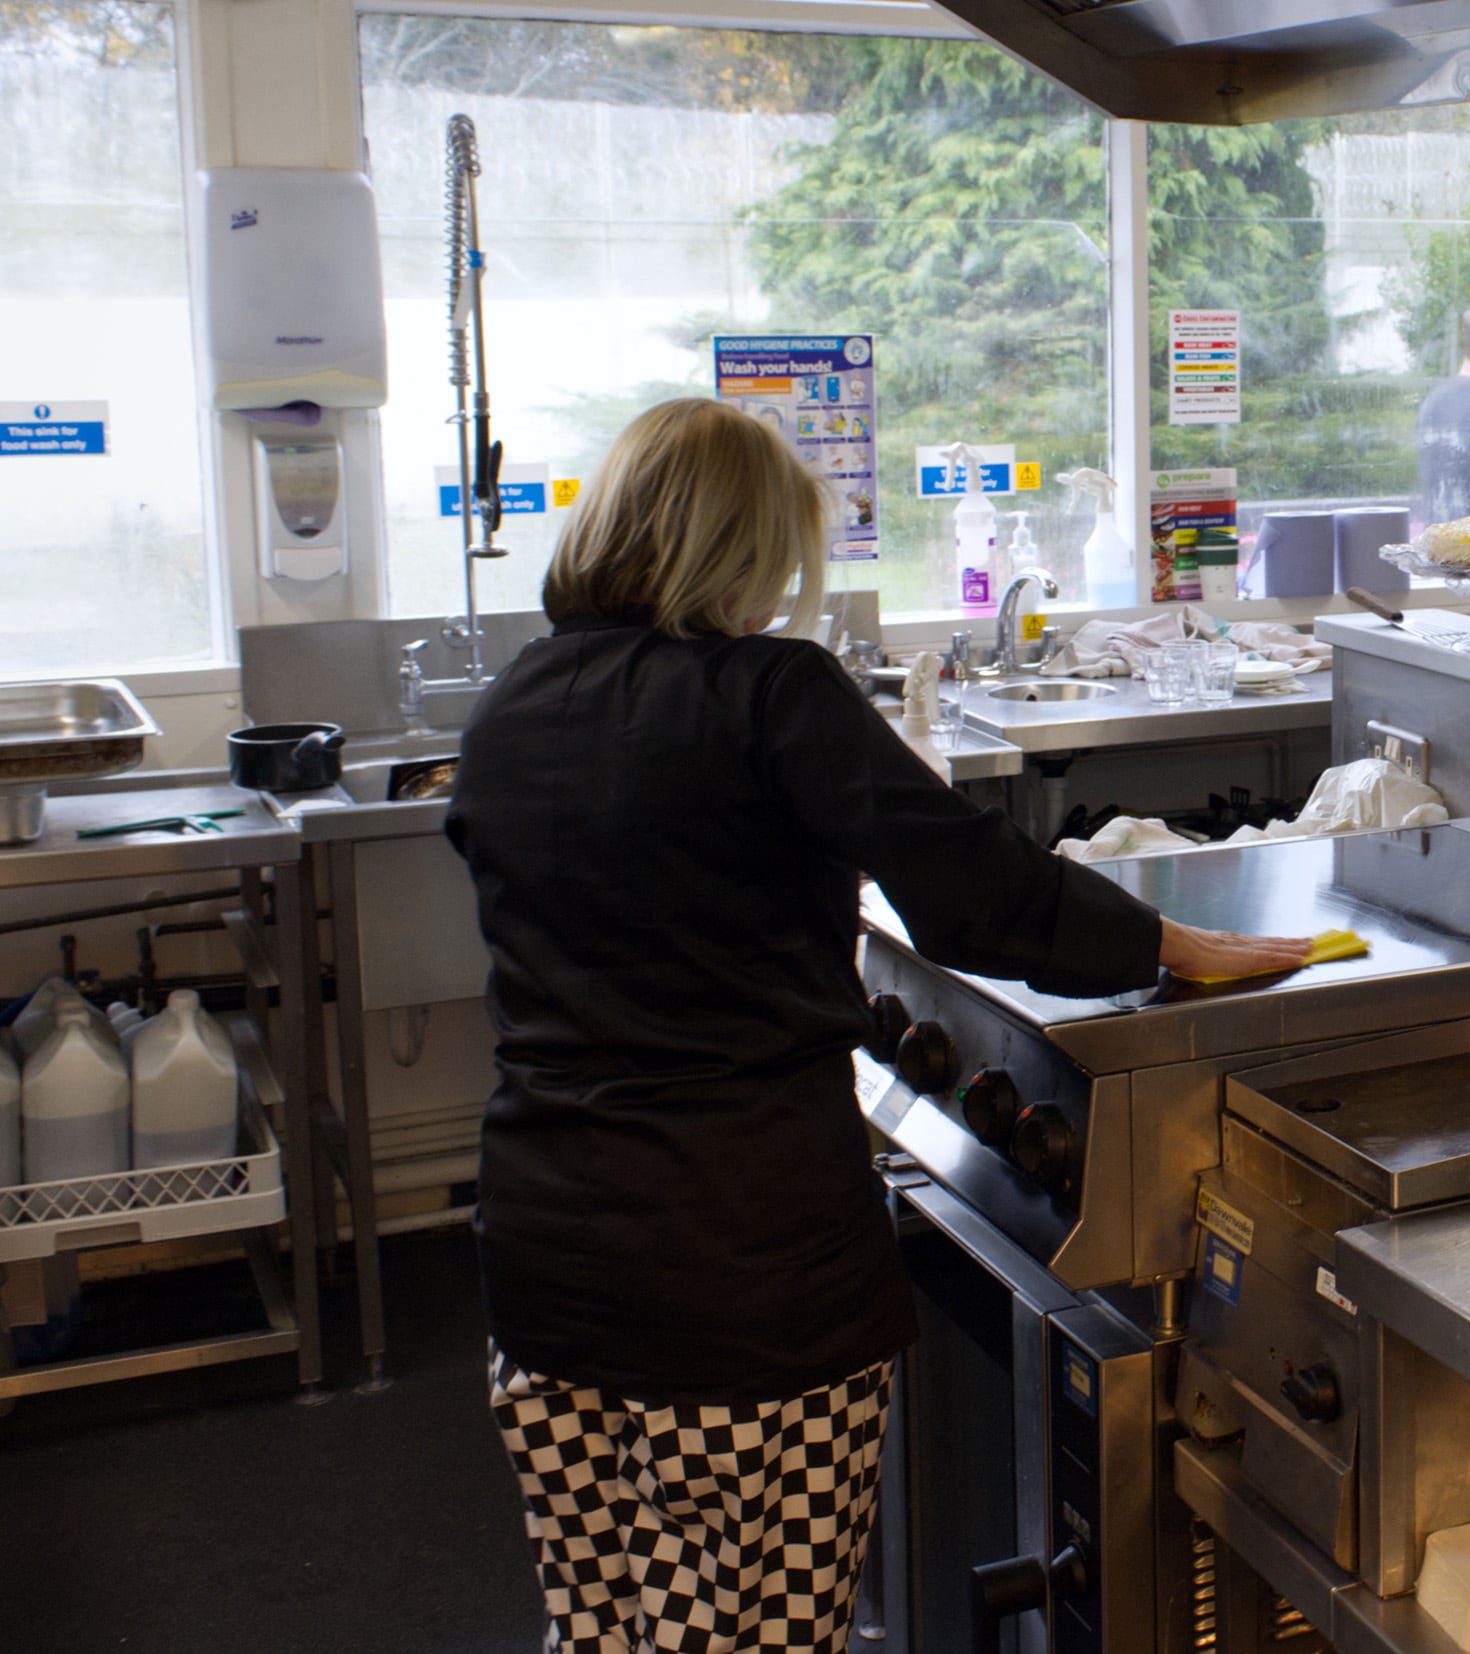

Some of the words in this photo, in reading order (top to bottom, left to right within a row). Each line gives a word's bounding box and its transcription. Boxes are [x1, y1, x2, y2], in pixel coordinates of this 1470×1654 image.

[719, 340, 749, 350] GOOD
[750, 340, 789, 350] HYGIENE
[790, 339, 838, 350] PRACTICES
[719, 361, 757, 375] Wash
[758, 362, 789, 377] your
[790, 360, 833, 374] hands!
[7, 427, 34, 437] This
[35, 427, 60, 437] sink
[61, 426, 79, 437] for
[0, 440, 28, 451] food
[29, 440, 60, 451] wash
[61, 440, 87, 452] only
